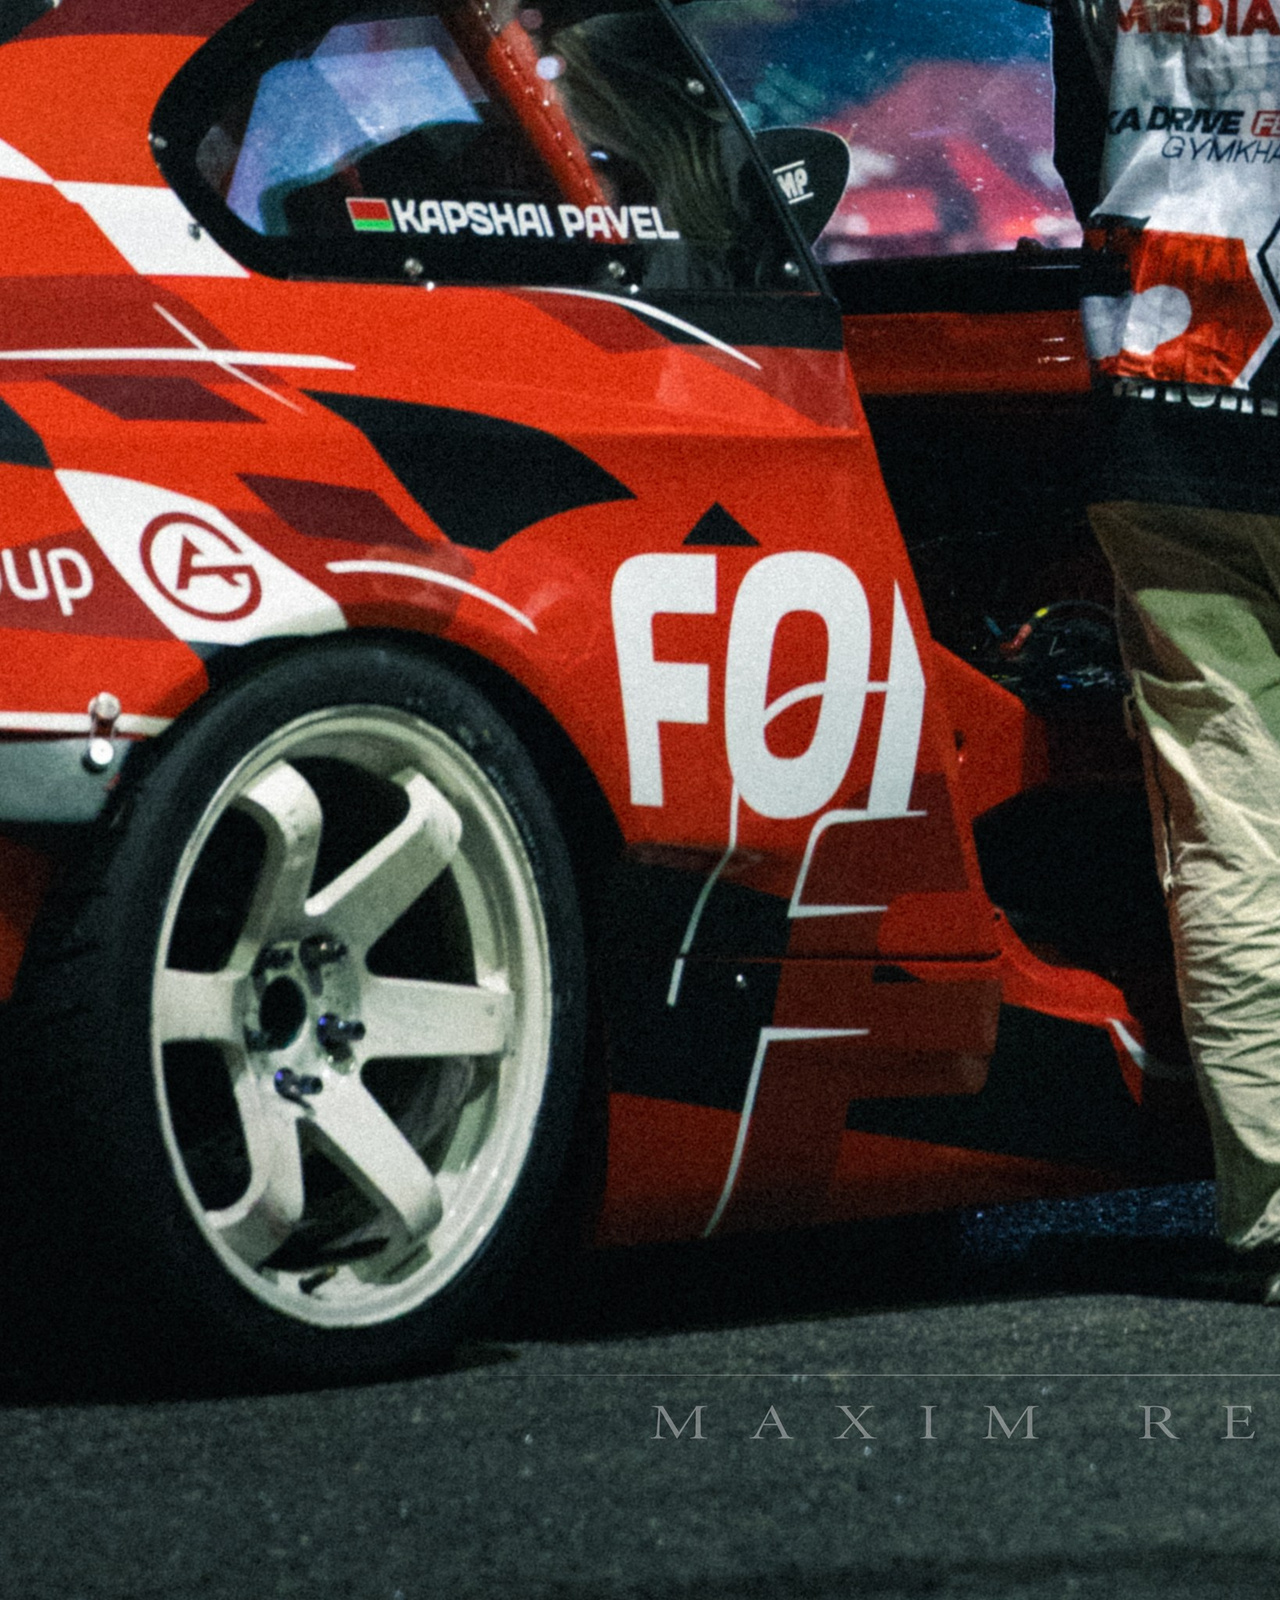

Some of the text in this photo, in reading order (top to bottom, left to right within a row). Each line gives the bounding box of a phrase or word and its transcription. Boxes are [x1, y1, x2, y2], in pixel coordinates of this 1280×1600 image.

[1146, 105, 1245, 135] DRIVE
[391, 199, 680, 240] KAPSHAI PAVEL
[0, 547, 94, 617] up
